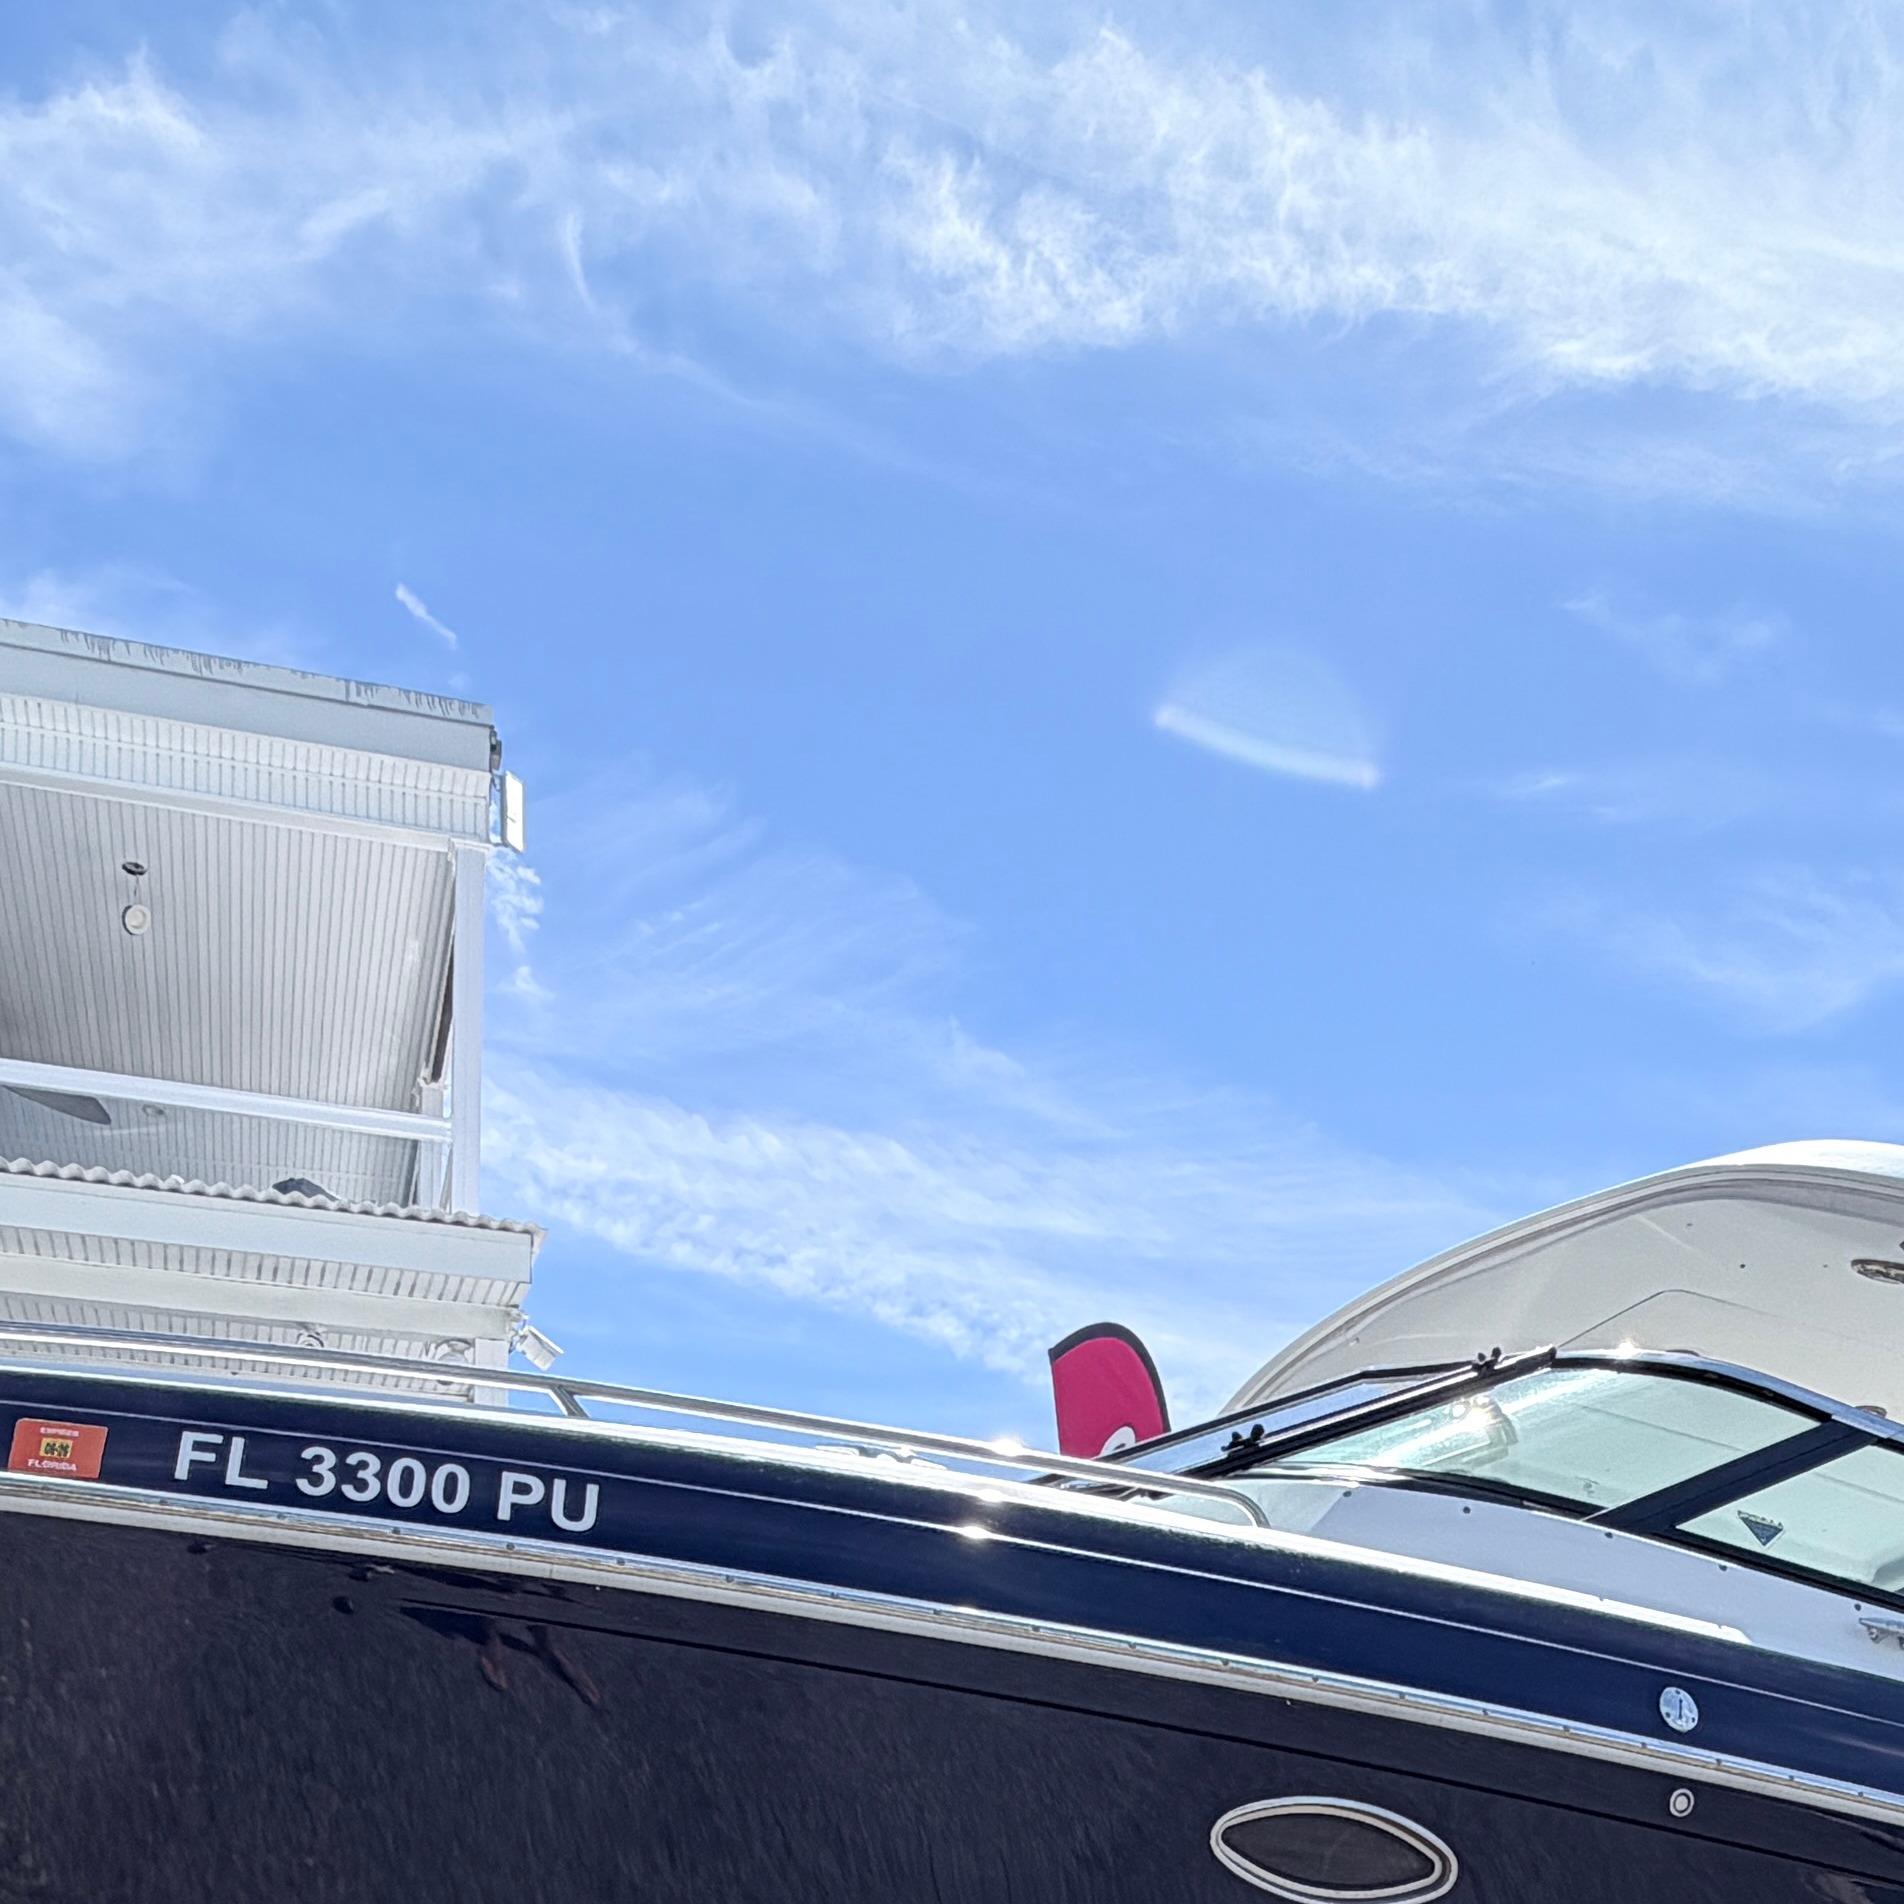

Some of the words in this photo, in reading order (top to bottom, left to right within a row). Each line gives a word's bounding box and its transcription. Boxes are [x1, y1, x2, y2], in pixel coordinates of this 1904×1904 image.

[174, 1430, 269, 1490] FL
[295, 1446, 471, 1514] 3300
[496, 1471, 600, 1533] PU
